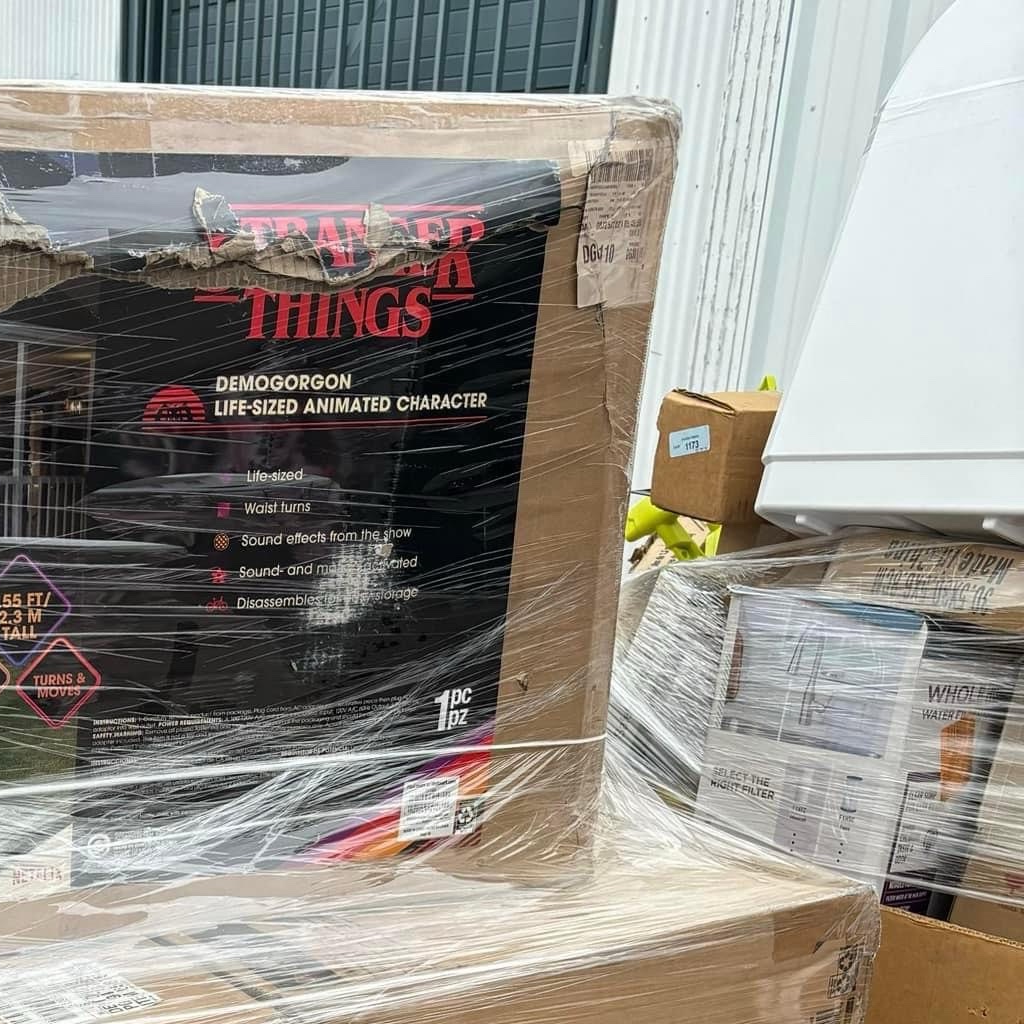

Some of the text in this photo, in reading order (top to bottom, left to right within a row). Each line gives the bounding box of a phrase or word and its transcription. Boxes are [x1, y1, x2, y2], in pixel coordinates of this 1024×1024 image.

[196, 216, 486, 291] TRANER
[244, 286, 433, 340] THINGS
[215, 373, 353, 393] DEMOGORGON
[214, 391, 488, 417] LIFE-SIZED ANIMATED CHARACTER
[247, 468, 304, 483] Life-sized
[244, 501, 311, 515] Waist turns
[241, 526, 412, 548] Sound effects from the show
[239, 563, 285, 579] Sound-
[287, 561, 313, 577] and
[958, 552, 1015, 585] Made
[27, 591, 52, 608] FT/
[236, 594, 322, 610] Disassembles
[375, 586, 419, 601] storage
[27, 608, 42, 624] M
[2, 625, 38, 641] TALL
[33, 672, 87, 686] TURNS &
[37, 686, 82, 699] MOVES
[434, 689, 450, 731] 1
[450, 688, 473, 708] pc
[447, 708, 469, 729] pz
[712, 766, 771, 788] SELECT THE
[742, 786, 776, 800] FILTER
